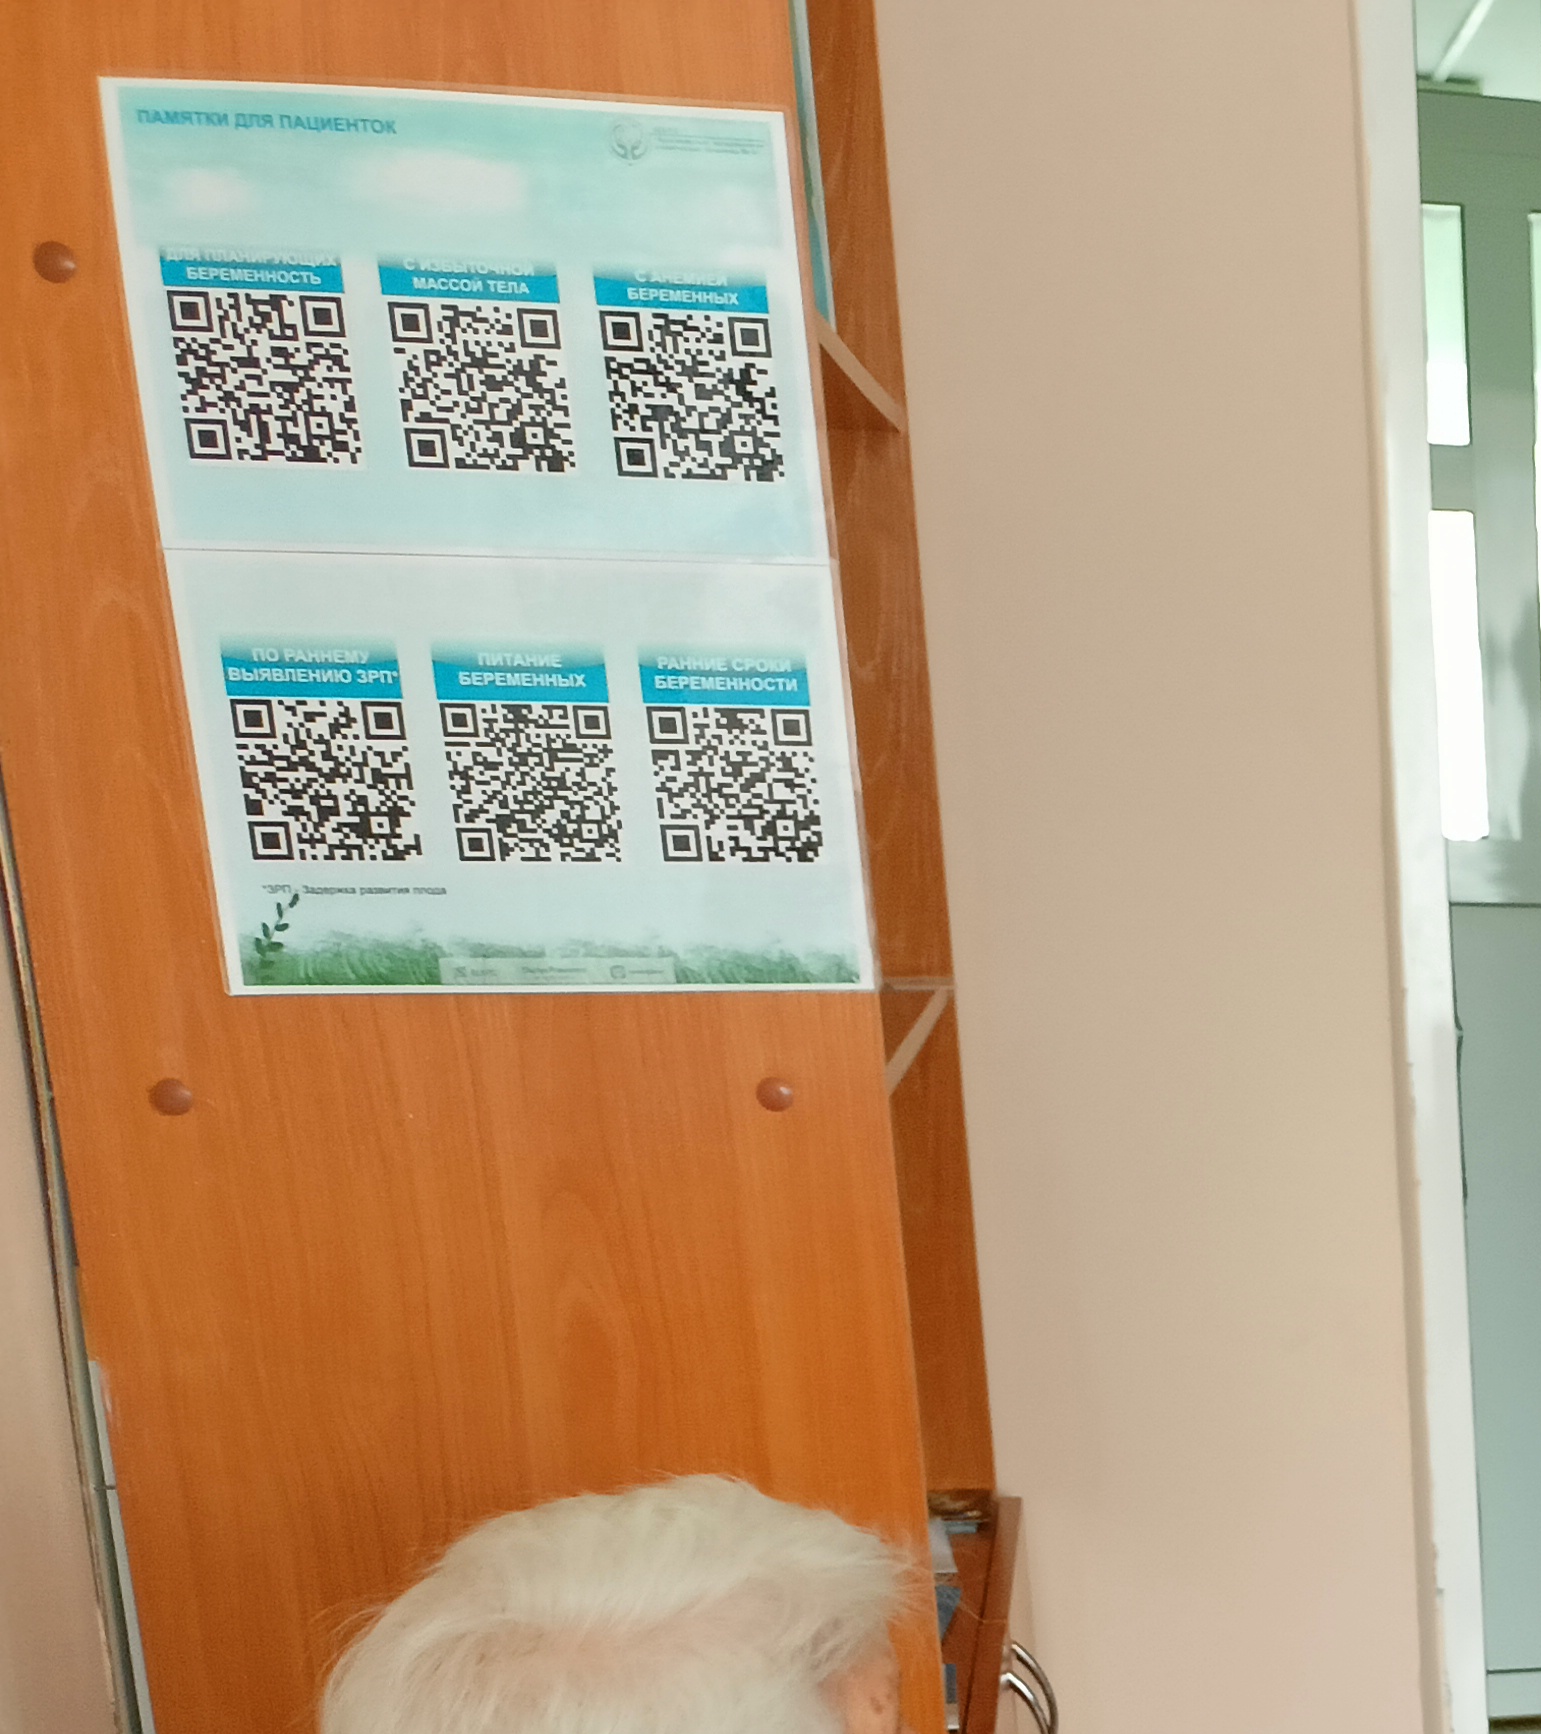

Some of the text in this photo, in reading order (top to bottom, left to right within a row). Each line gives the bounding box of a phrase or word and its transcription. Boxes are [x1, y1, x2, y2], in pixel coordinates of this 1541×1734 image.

[136, 109, 398, 135] ПАМЯТКИ ДЛЯ ПАЦИЕНТОК
[186, 266, 322, 285] БЕРЕМЕННОСТЬ
[403, 257, 536, 276] С ИЗБЫТОЧНОЙ
[412, 275, 531, 295] МАССОЙ ТЕЛА
[626, 286, 740, 306] БЕРЕМЕННЫХ
[252, 647, 371, 665] ПО РАННЕМУ
[476, 651, 564, 669] ПИТАНИЕ
[656, 655, 793, 673] РАННИЕ СРОКИ
[227, 666, 353, 684] ВЫЯВЛЕНИЮ
[457, 670, 588, 688] БЕРЕМЕННЫХ
[653, 674, 799, 693] БЕРЕМЕННОСТИ
